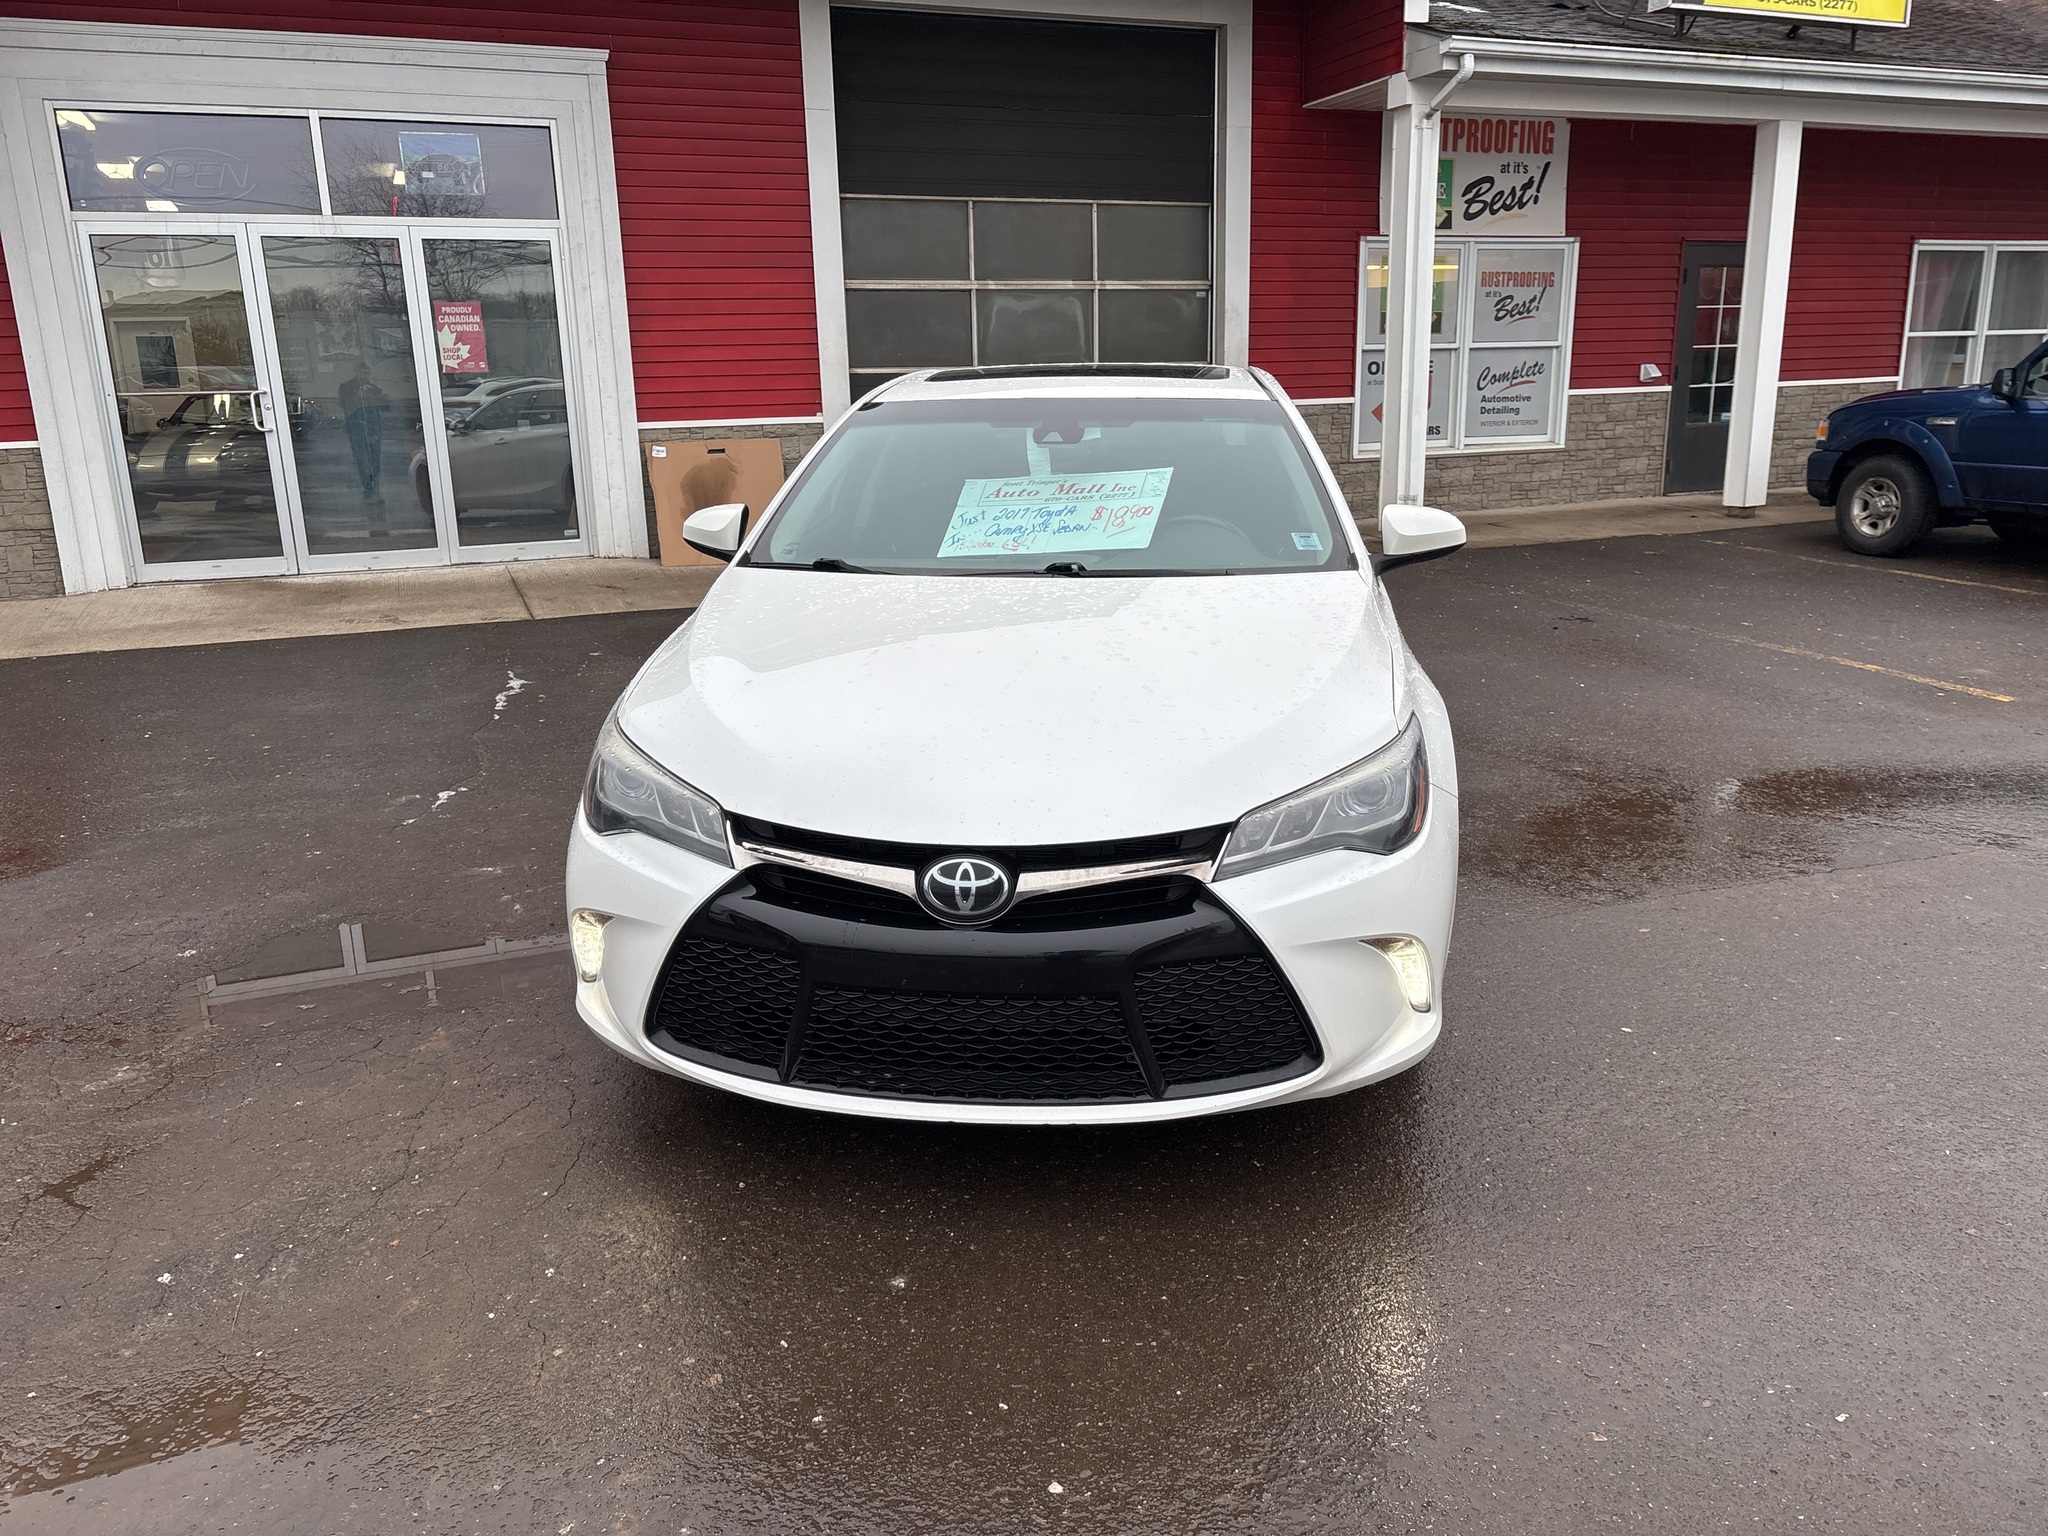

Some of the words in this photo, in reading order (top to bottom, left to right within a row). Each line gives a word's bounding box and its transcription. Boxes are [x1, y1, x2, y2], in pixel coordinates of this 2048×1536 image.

[1820, 0, 1858, 13] (2277)
[1441, 118, 1555, 155] TPROOFING
[140, 156, 249, 190] OPEN
[1500, 162, 1511, 174] at
[1513, 161, 1529, 174] it's
[1461, 161, 1552, 221] Best!
[1480, 271, 1555, 287] RUSTPROOFING
[1485, 290, 1492, 298] at
[1493, 286, 1547, 322] Best!
[438, 314, 480, 323] CANADIAN
[1476, 360, 1546, 391] Complete
[1480, 394, 1532, 403] Automotive
[1480, 405, 1521, 416] Detailing
[1511, 419, 1539, 427] EXTERIOR
[983, 487, 1040, 499] Auto
[1050, 483, 1106, 496] Mall
[1110, 483, 1137, 493] Inc
[993, 507, 1030, 521] 2017
